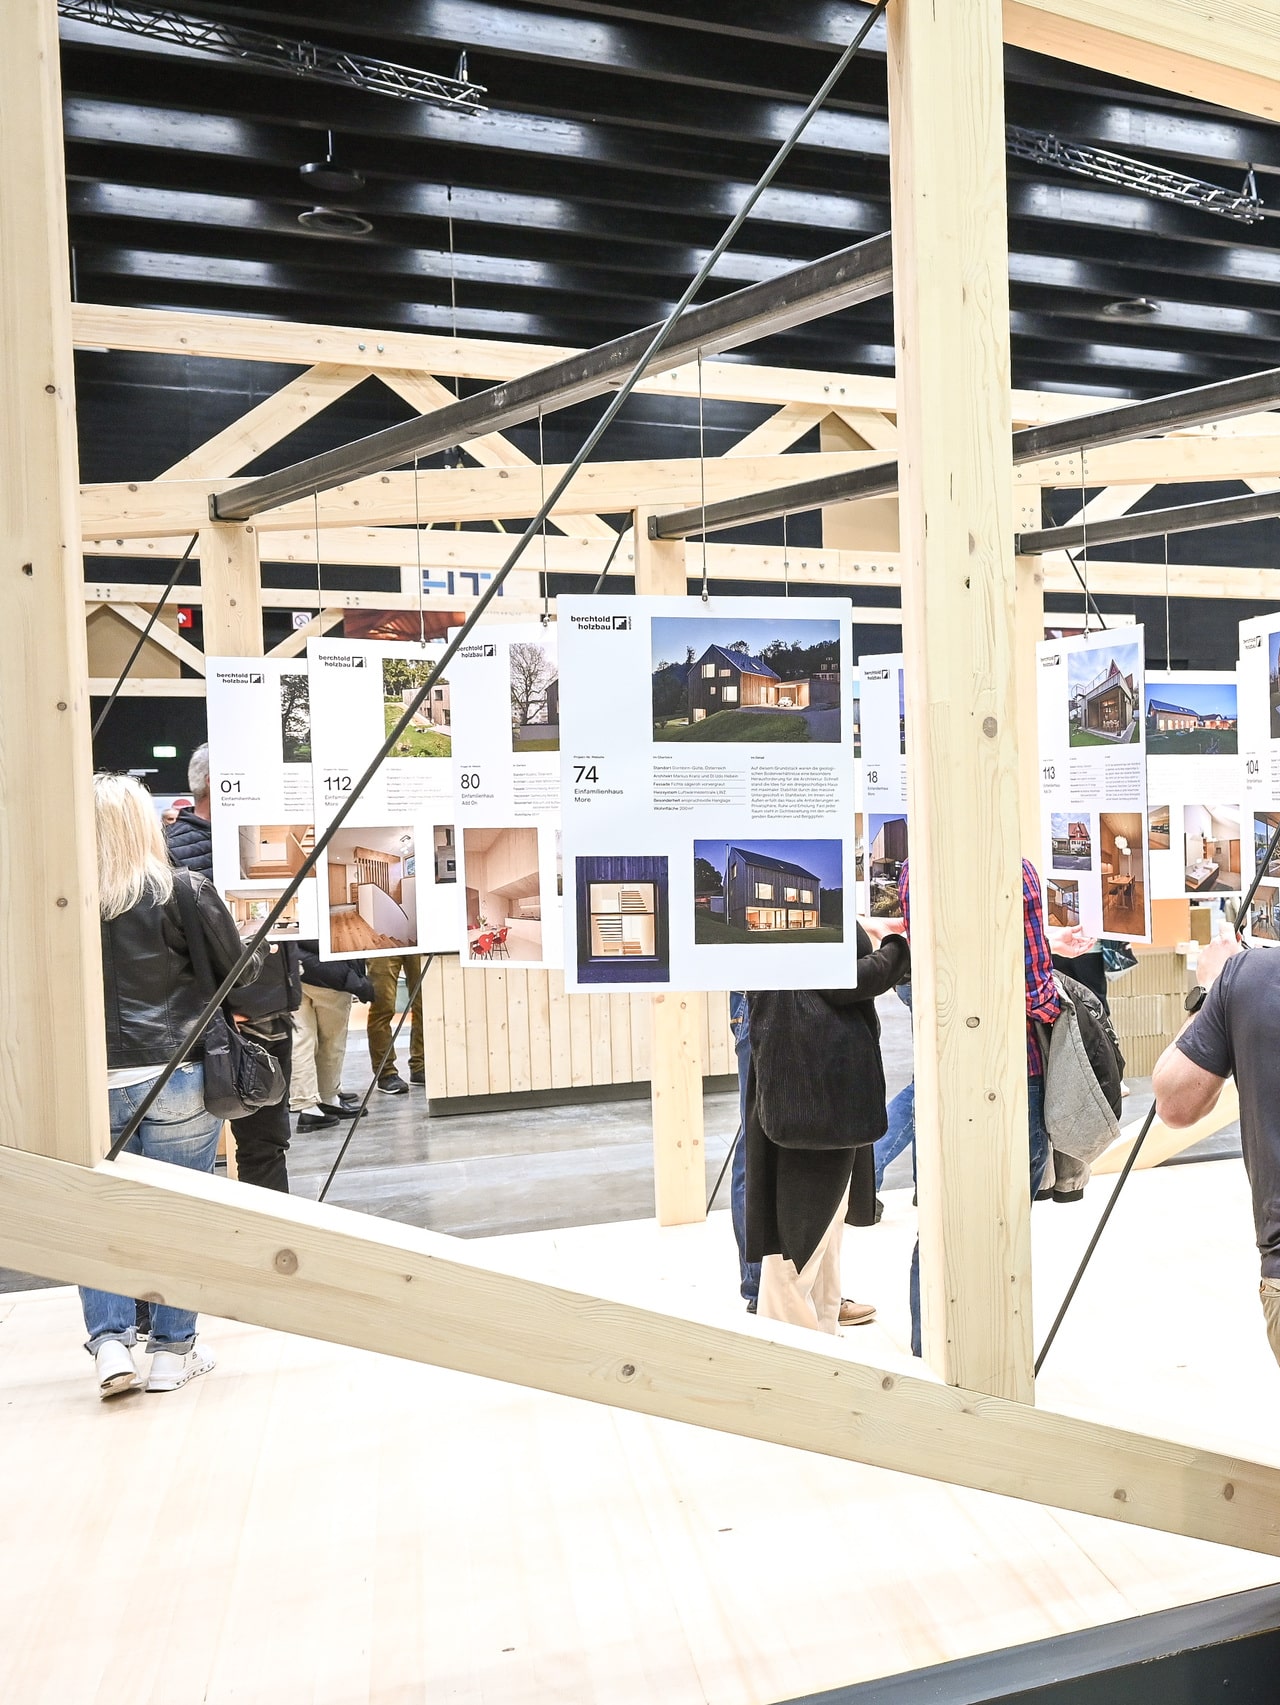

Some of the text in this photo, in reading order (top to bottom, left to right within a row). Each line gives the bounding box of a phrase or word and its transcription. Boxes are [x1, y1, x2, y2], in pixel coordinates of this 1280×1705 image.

[318, 654, 351, 662] berchtold
[573, 765, 599, 783] 74
[1043, 766, 1055, 780] 113
[1246, 760, 1259, 774] 104
[323, 776, 352, 791] 112
[460, 773, 480, 789] 80
[867, 771, 878, 783] 18
[220, 780, 241, 793] 01
